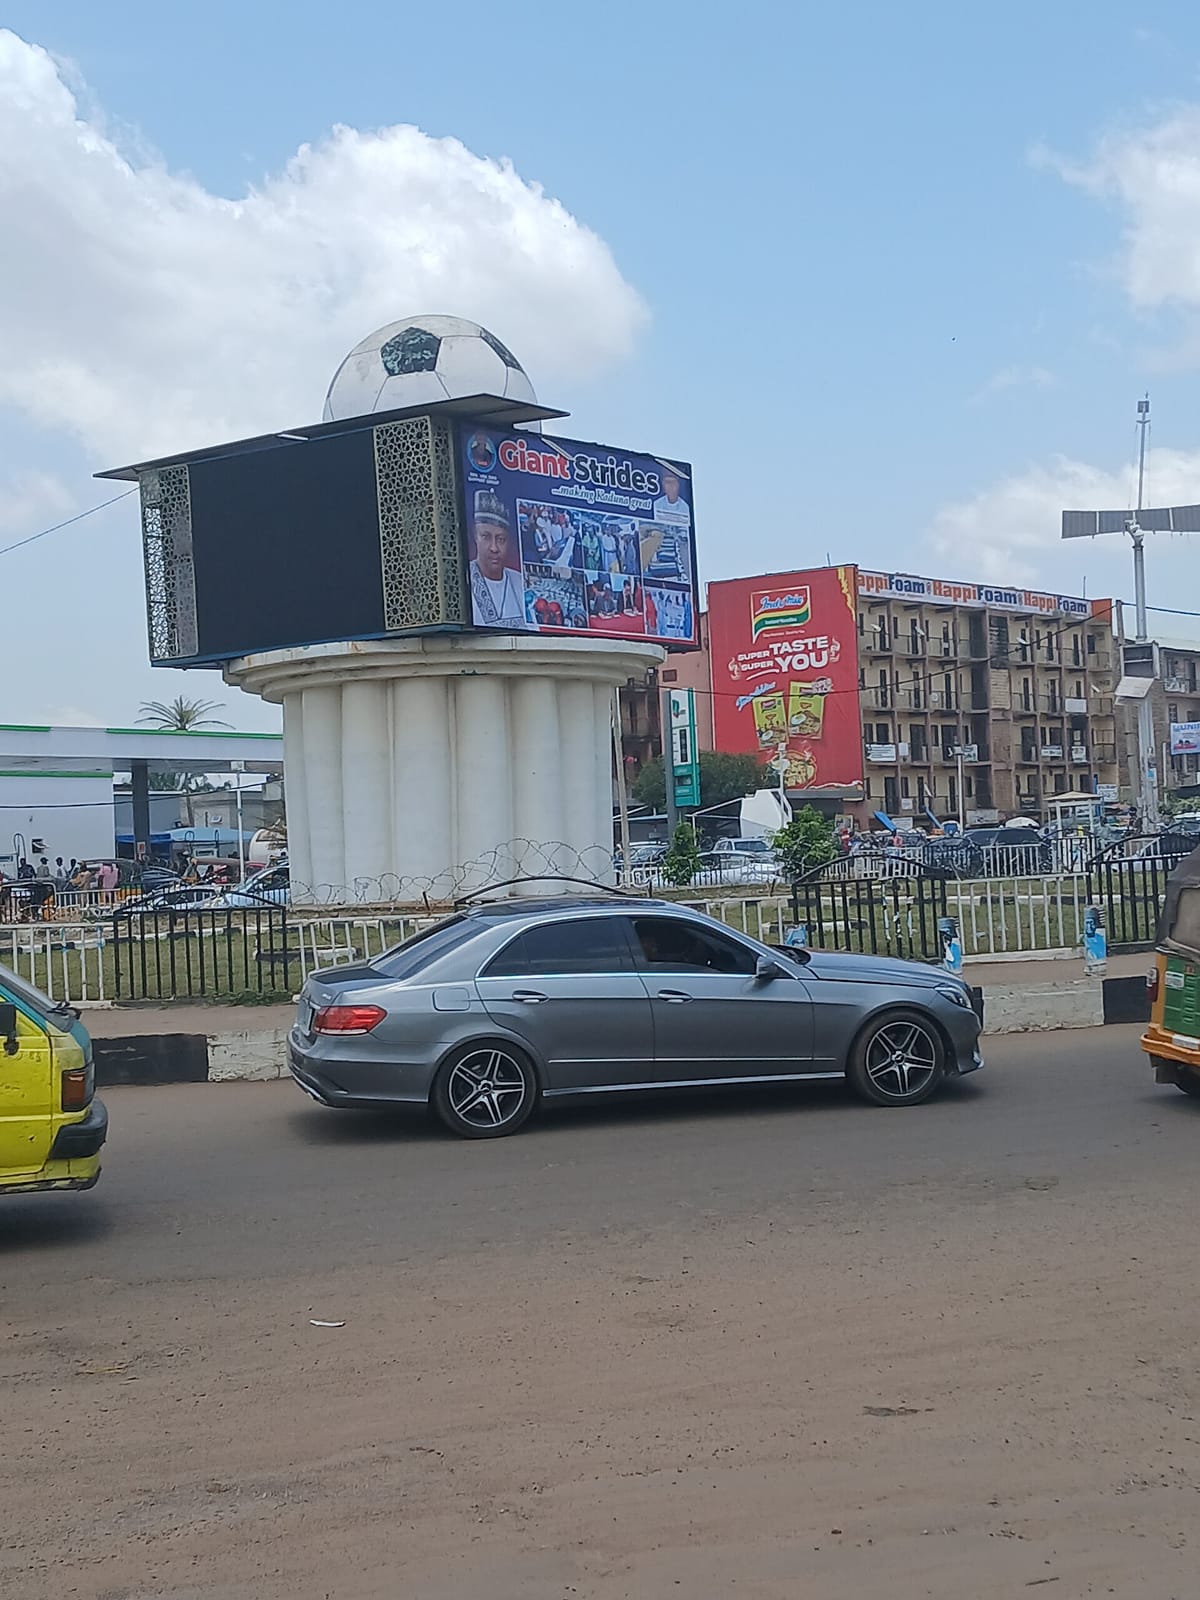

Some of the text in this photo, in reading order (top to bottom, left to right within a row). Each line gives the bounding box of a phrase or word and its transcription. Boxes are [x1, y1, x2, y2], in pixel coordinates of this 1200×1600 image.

[499, 439, 660, 495] Giant Strides
[595, 488, 630, 507] Kaduna
[629, 497, 652, 511] great
[857, 573, 925, 594] appiFoam
[737, 636, 829, 662] SUPER TASTE
[740, 650, 829, 673] SUPER YOU
